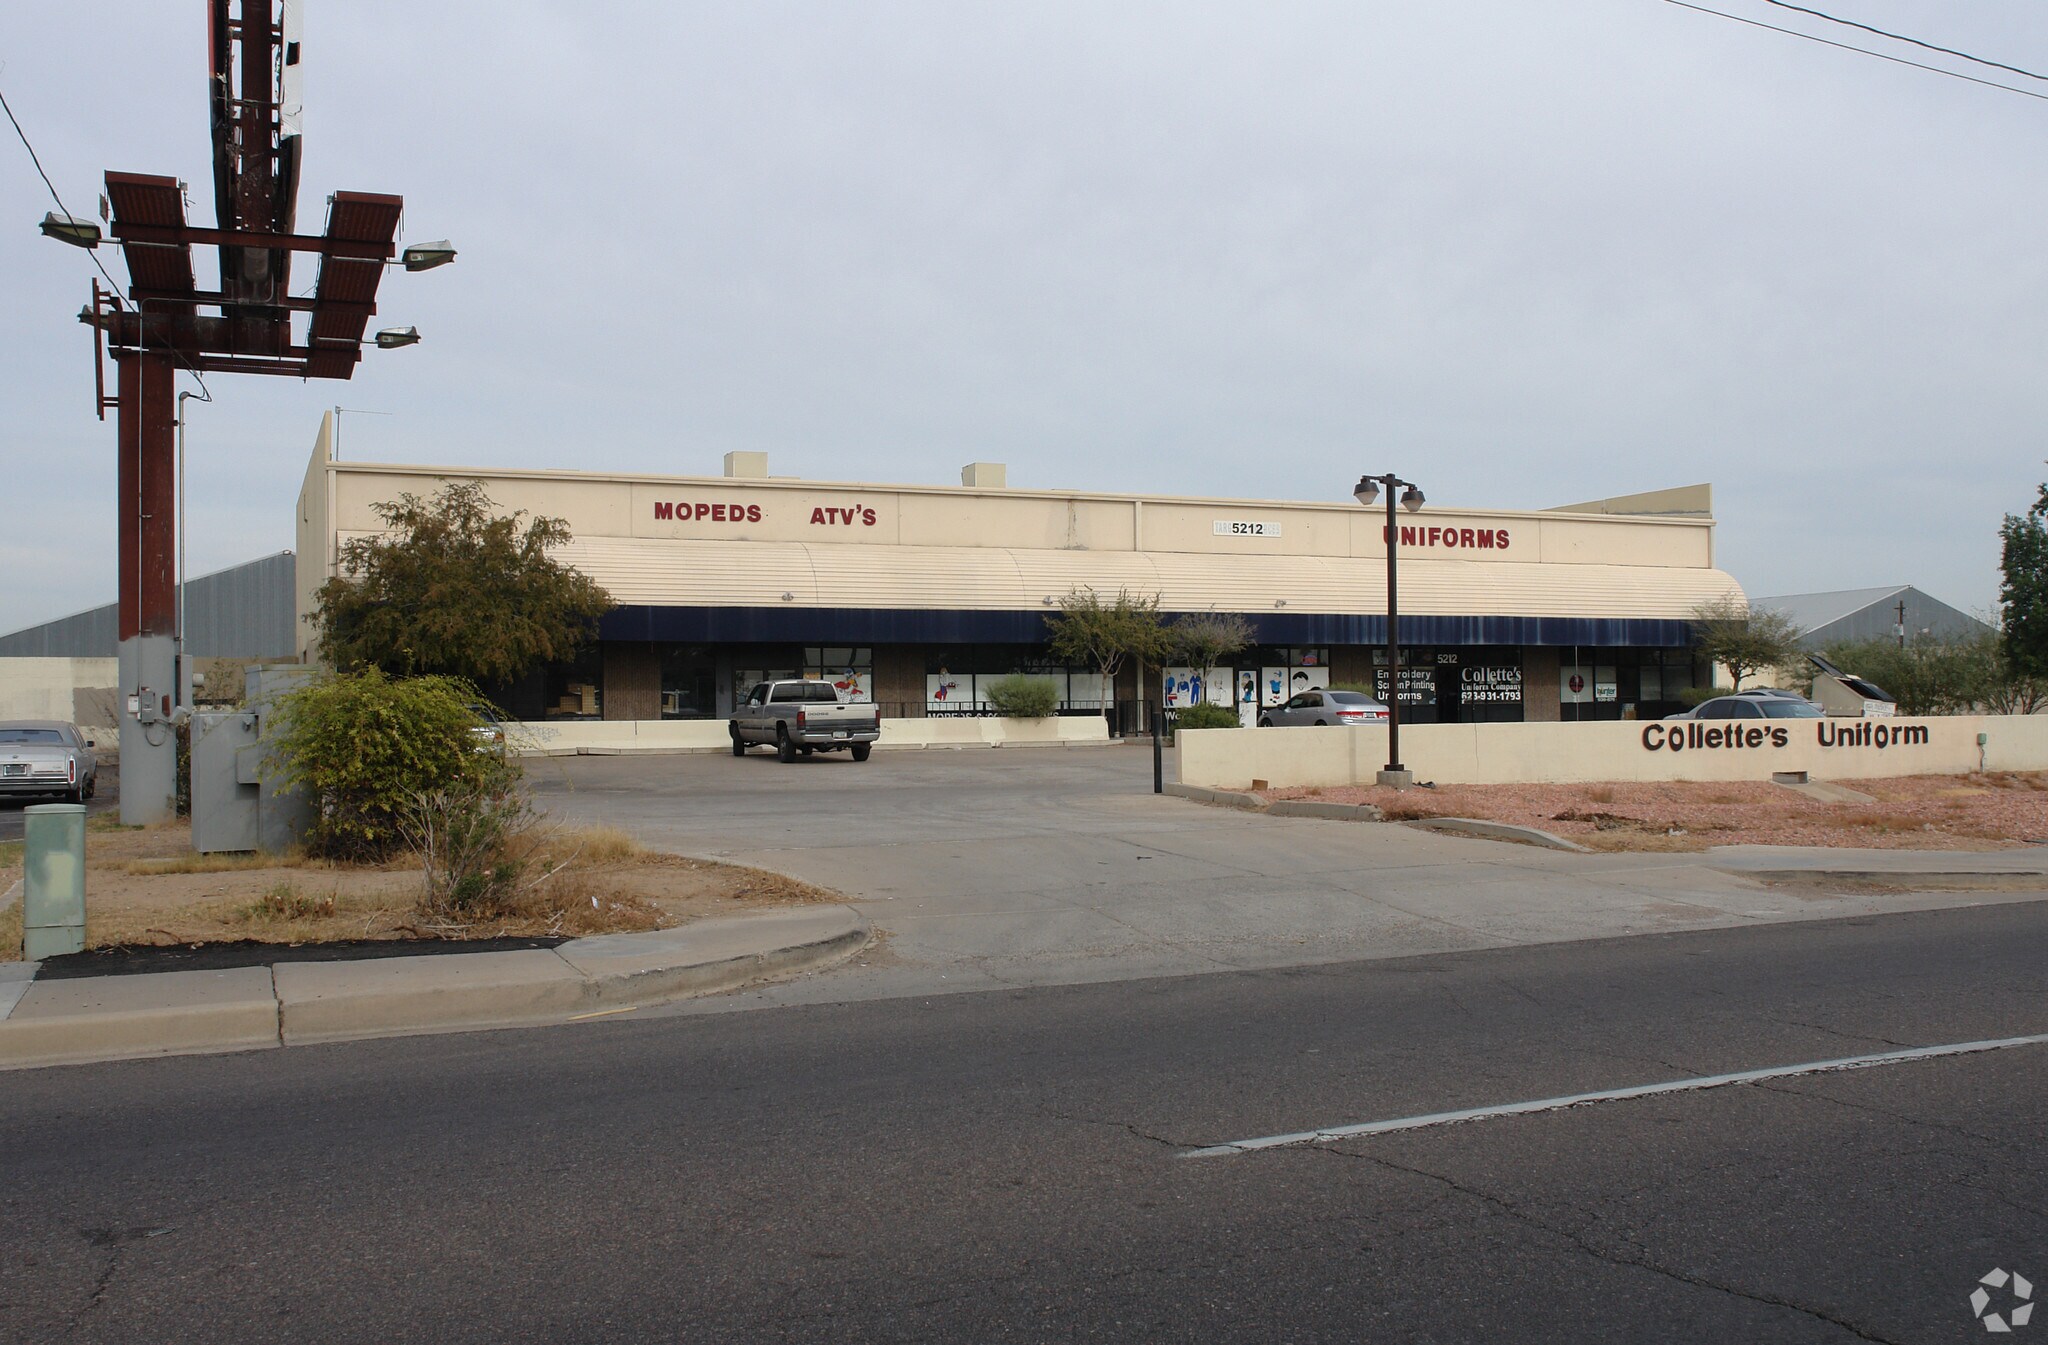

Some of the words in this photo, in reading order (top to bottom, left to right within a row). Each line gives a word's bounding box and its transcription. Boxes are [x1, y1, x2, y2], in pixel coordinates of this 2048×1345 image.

[654, 502, 762, 523] MOPEDS
[810, 504, 877, 526] ATV'S
[1232, 523, 1263, 534] 5212
[1437, 654, 1458, 664] 5212
[1377, 669, 1431, 680] Emroidery
[1461, 667, 1522, 682] Collette's
[1405, 680, 1436, 691] Printing
[1461, 683, 1489, 691] Uniform
[1490, 683, 1521, 692] Company
[1377, 691, 1422, 700] Unorms
[1461, 692, 1521, 701] 623-931-1793
[1642, 723, 1788, 751] Collette's
[1817, 721, 1929, 749] Uniform
